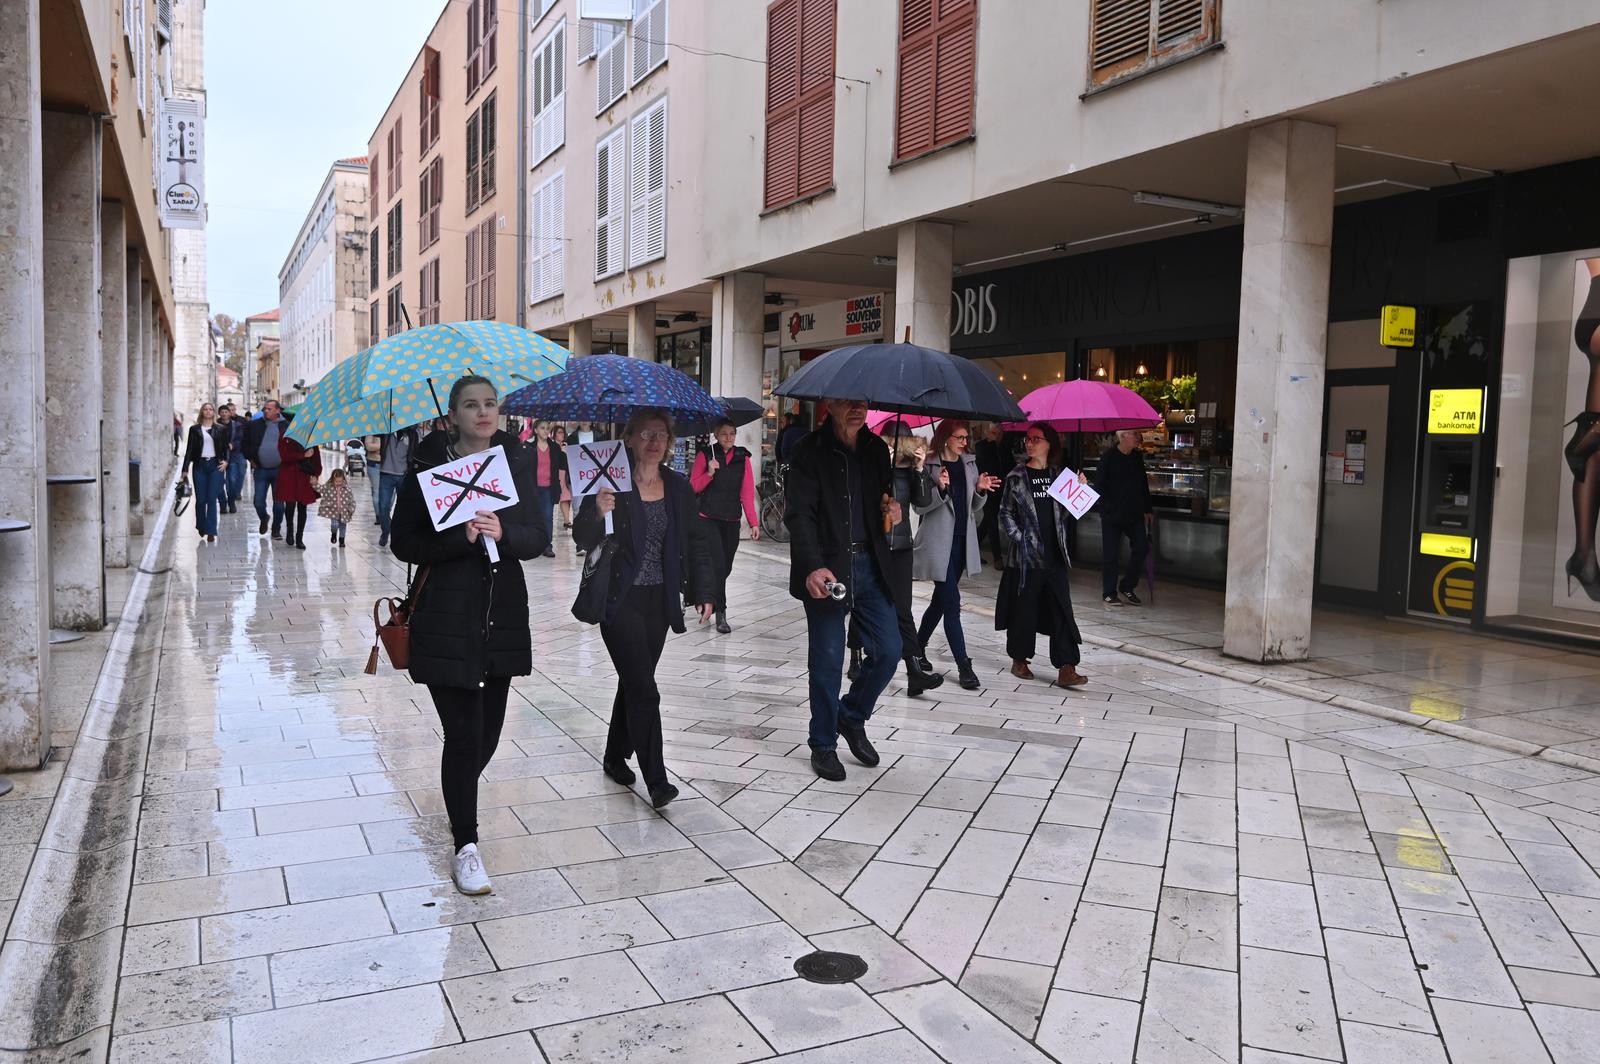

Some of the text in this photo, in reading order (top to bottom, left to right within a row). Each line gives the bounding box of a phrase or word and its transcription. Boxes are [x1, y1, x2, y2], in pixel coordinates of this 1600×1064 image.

[189, 121, 197, 155] Room
[854, 295, 882, 311] BOOK &
[846, 307, 882, 324] SOUVENIR
[861, 320, 882, 334] SHOP
[1399, 328, 1414, 336] ATM
[1453, 411, 1476, 420] ATM
[579, 465, 627, 481] POTRDE
[1059, 478, 1093, 514] NE!
